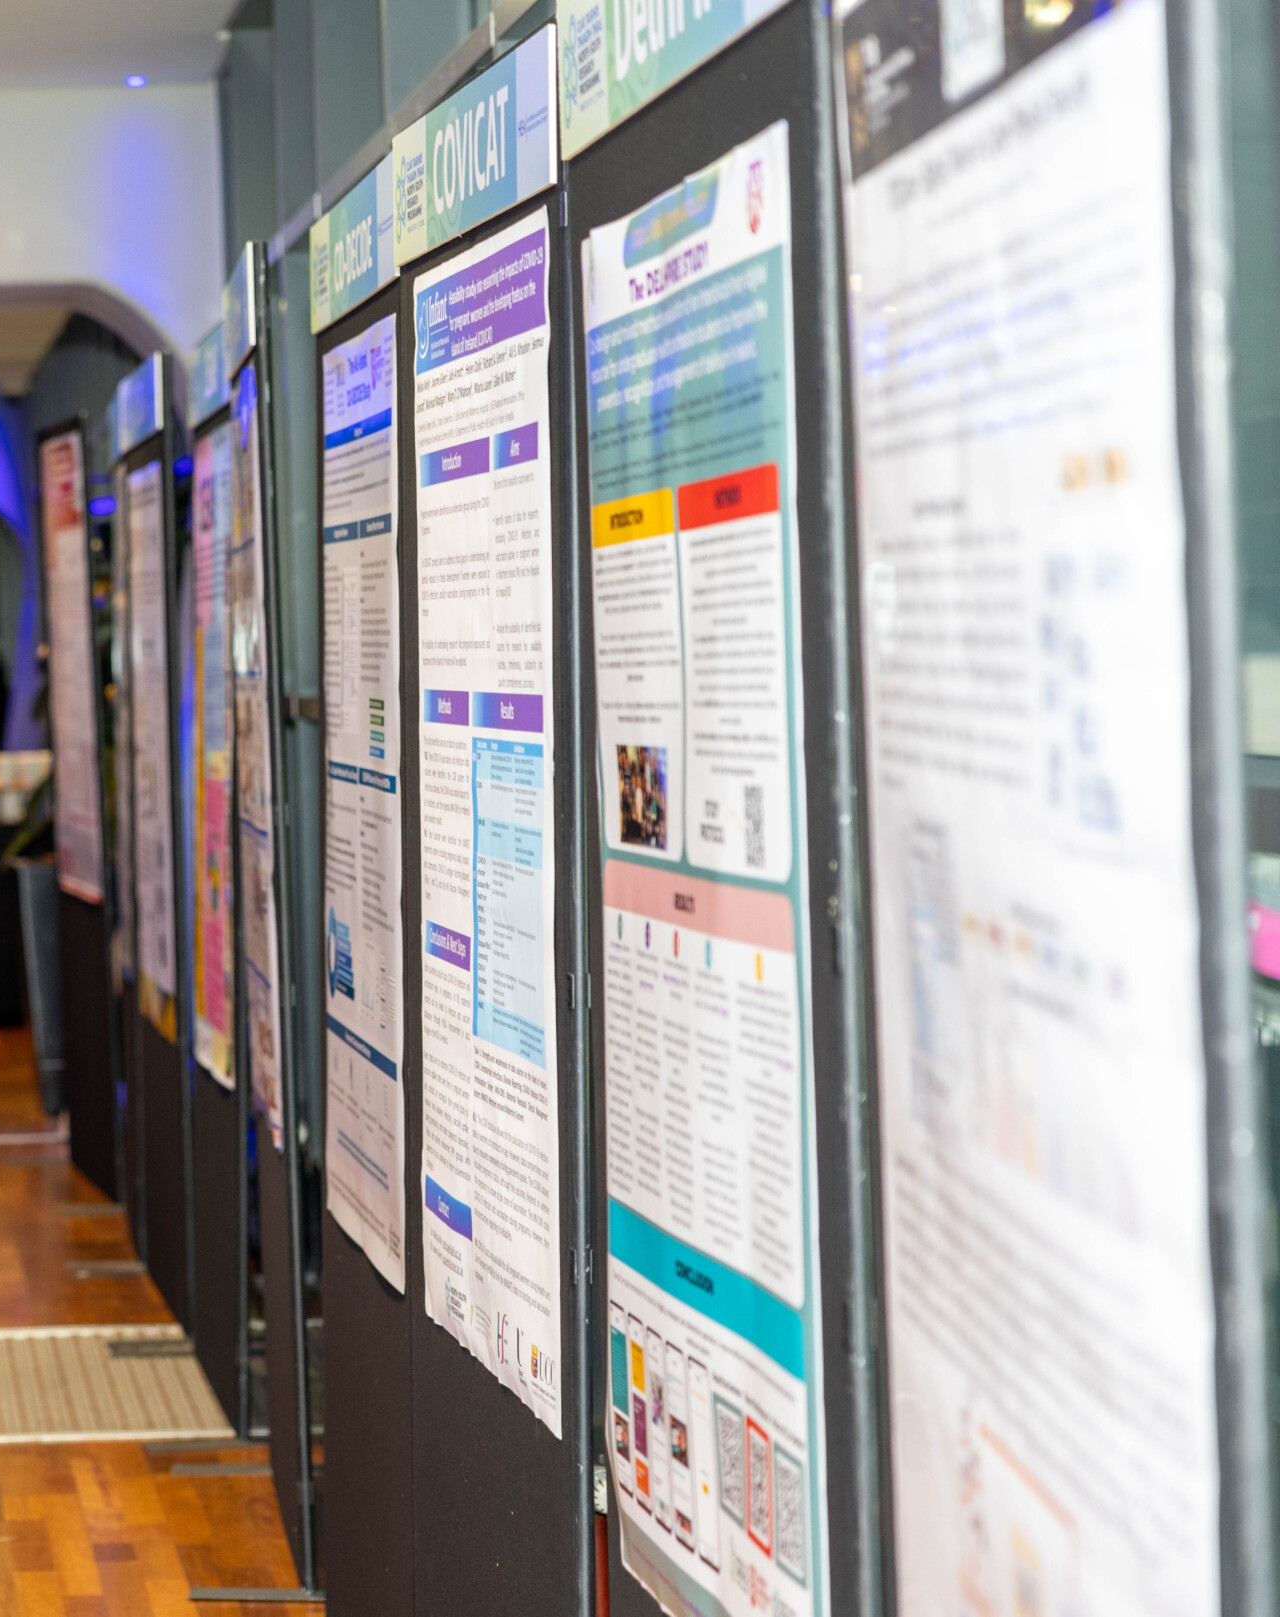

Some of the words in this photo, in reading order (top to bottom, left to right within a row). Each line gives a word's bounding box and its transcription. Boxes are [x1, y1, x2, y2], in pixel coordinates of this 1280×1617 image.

[433, 85, 509, 214] COVICAT
[334, 214, 373, 292] CO-DECIDE
[523, 248, 543, 269] COVID-19
[510, 439, 520, 457] Aims
[442, 452, 462, 472] Introduction
[437, 697, 451, 714] Methods
[500, 700, 514, 720] Results
